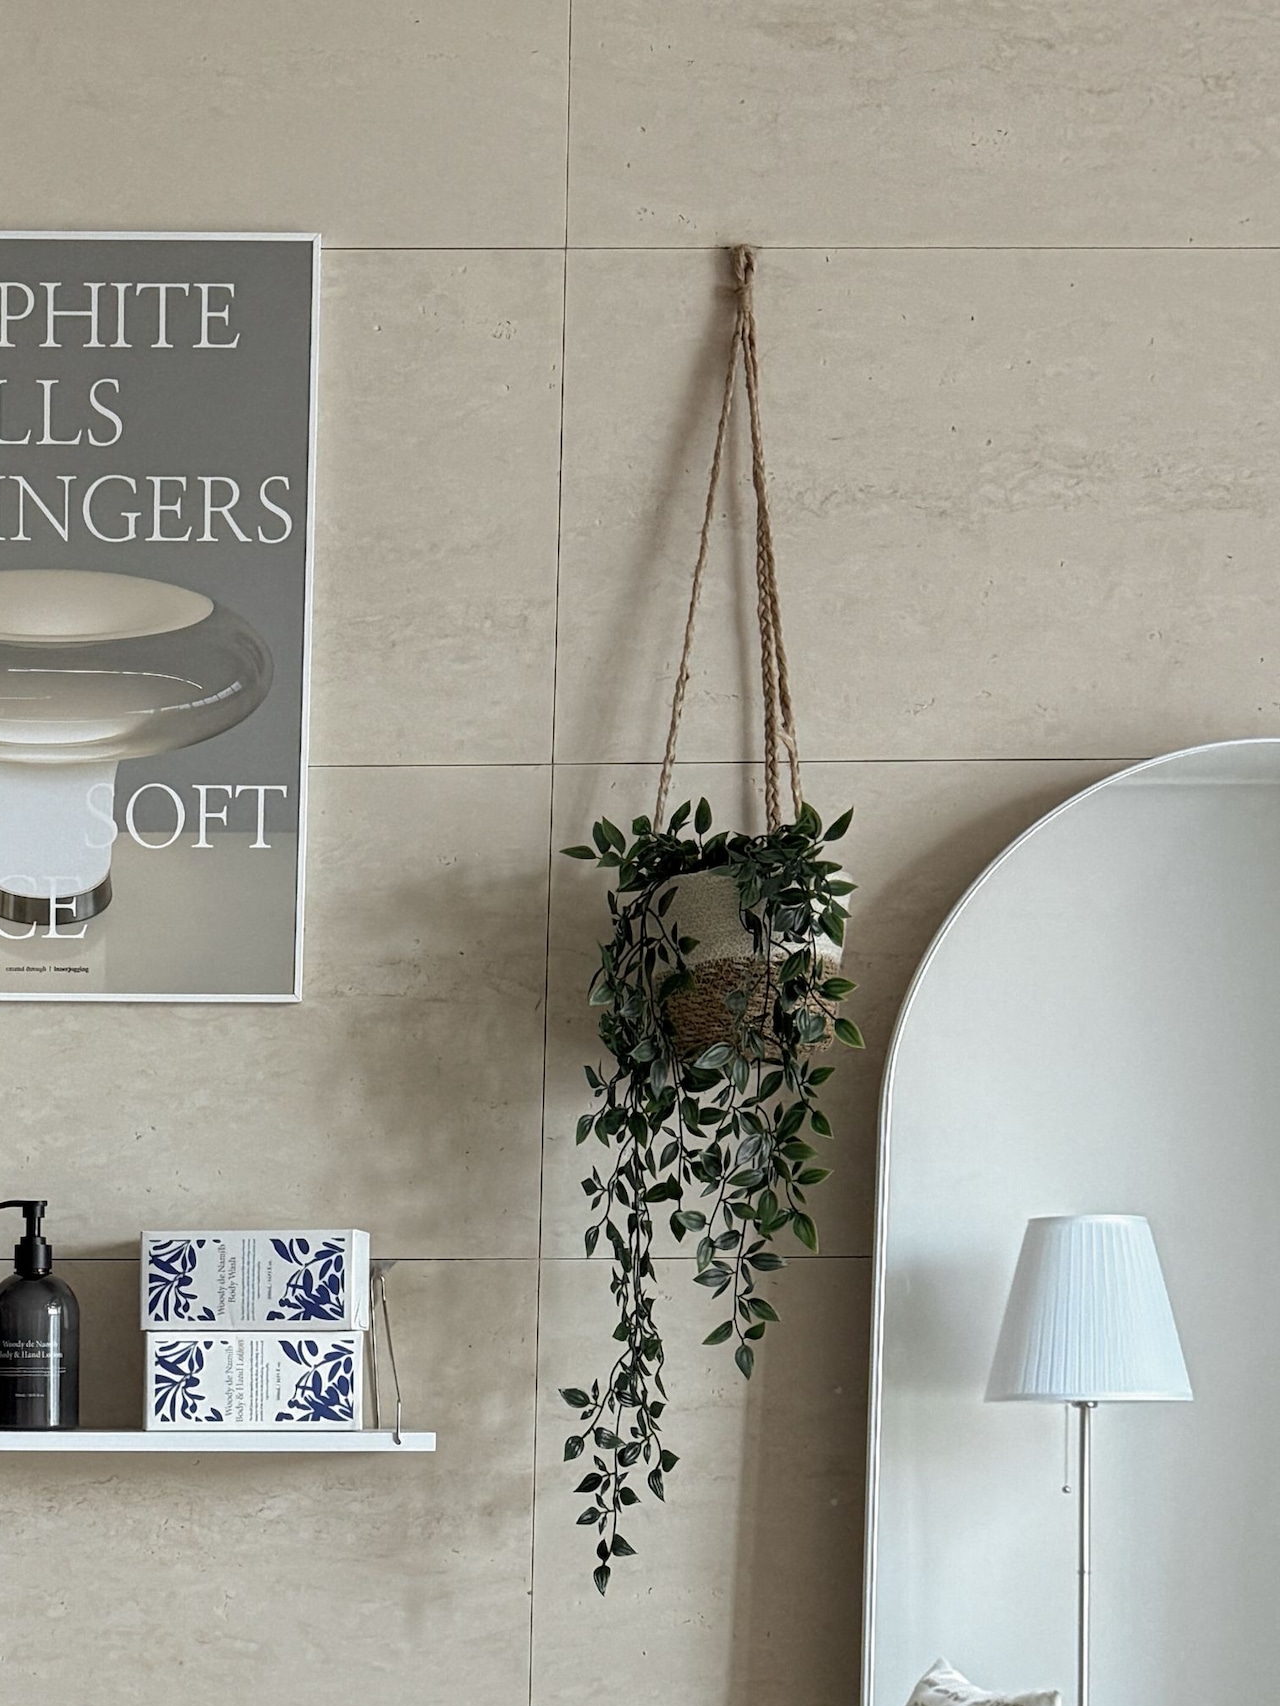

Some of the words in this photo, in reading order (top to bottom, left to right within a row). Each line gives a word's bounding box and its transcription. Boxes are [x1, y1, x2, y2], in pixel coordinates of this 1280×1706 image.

[84, 782, 288, 849] SOFT
[217, 1243, 226, 1273] Namib
[227, 1256, 236, 1280] Wash
[217, 1273, 226, 1285] de
[217, 1286, 228, 1316] Woody
[227, 1280, 239, 1303] Body
[13, 1351, 20, 1359] &
[21, 1351, 41, 1359] Hand
[25, 1340, 35, 1348] de
[225, 1374, 233, 1386] de
[235, 1368, 244, 1391] Hand
[224, 1387, 236, 1416] Woody
[235, 1392, 244, 1401] &
[235, 1402, 246, 1422] Body
